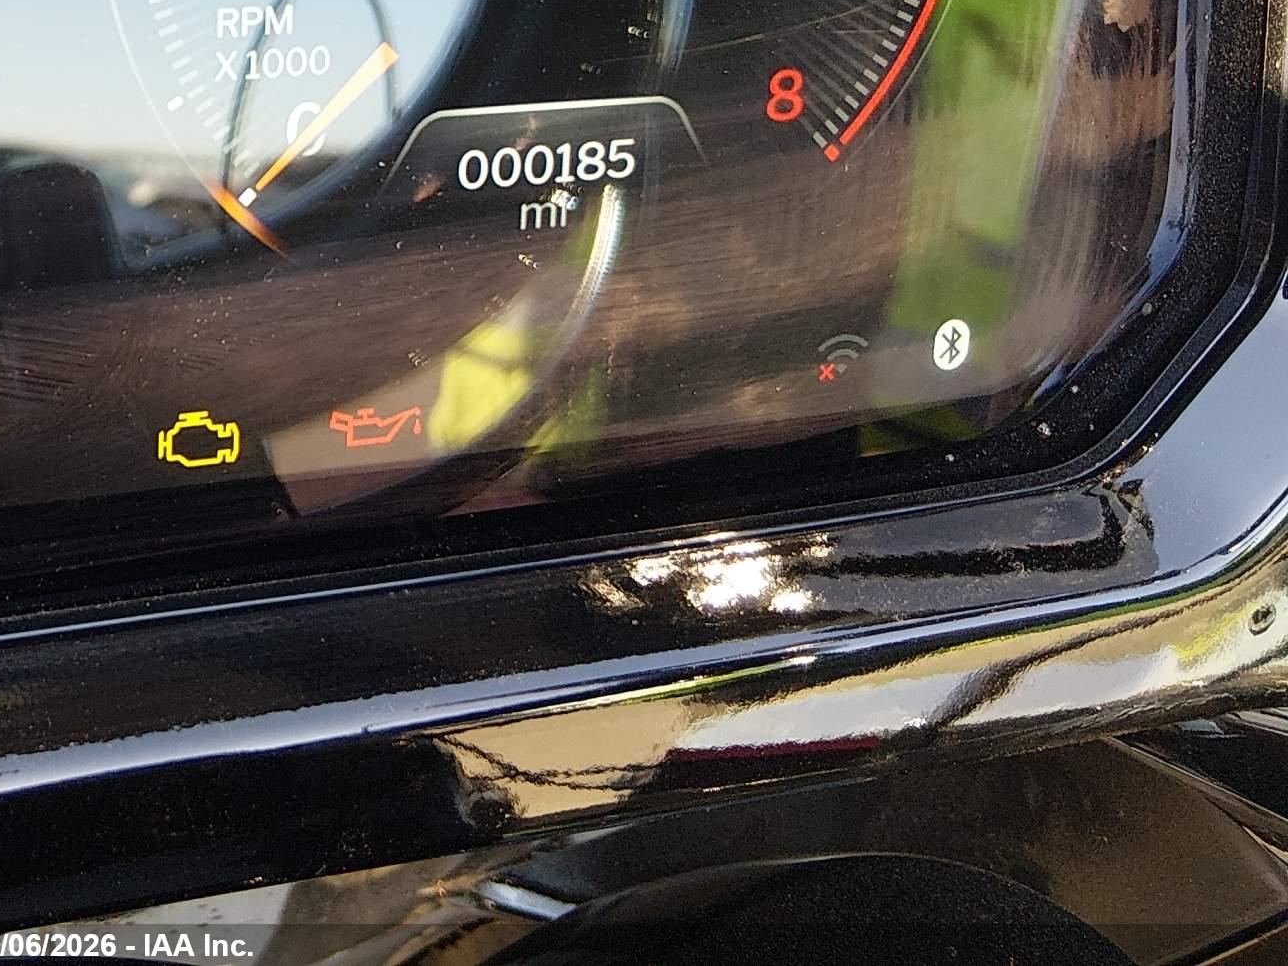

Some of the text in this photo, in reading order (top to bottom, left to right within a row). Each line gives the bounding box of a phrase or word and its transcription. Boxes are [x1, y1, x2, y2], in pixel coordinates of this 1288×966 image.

[216, 4, 294, 39] RPM
[766, 68, 805, 123] 8
[457, 138, 636, 191] 000185
